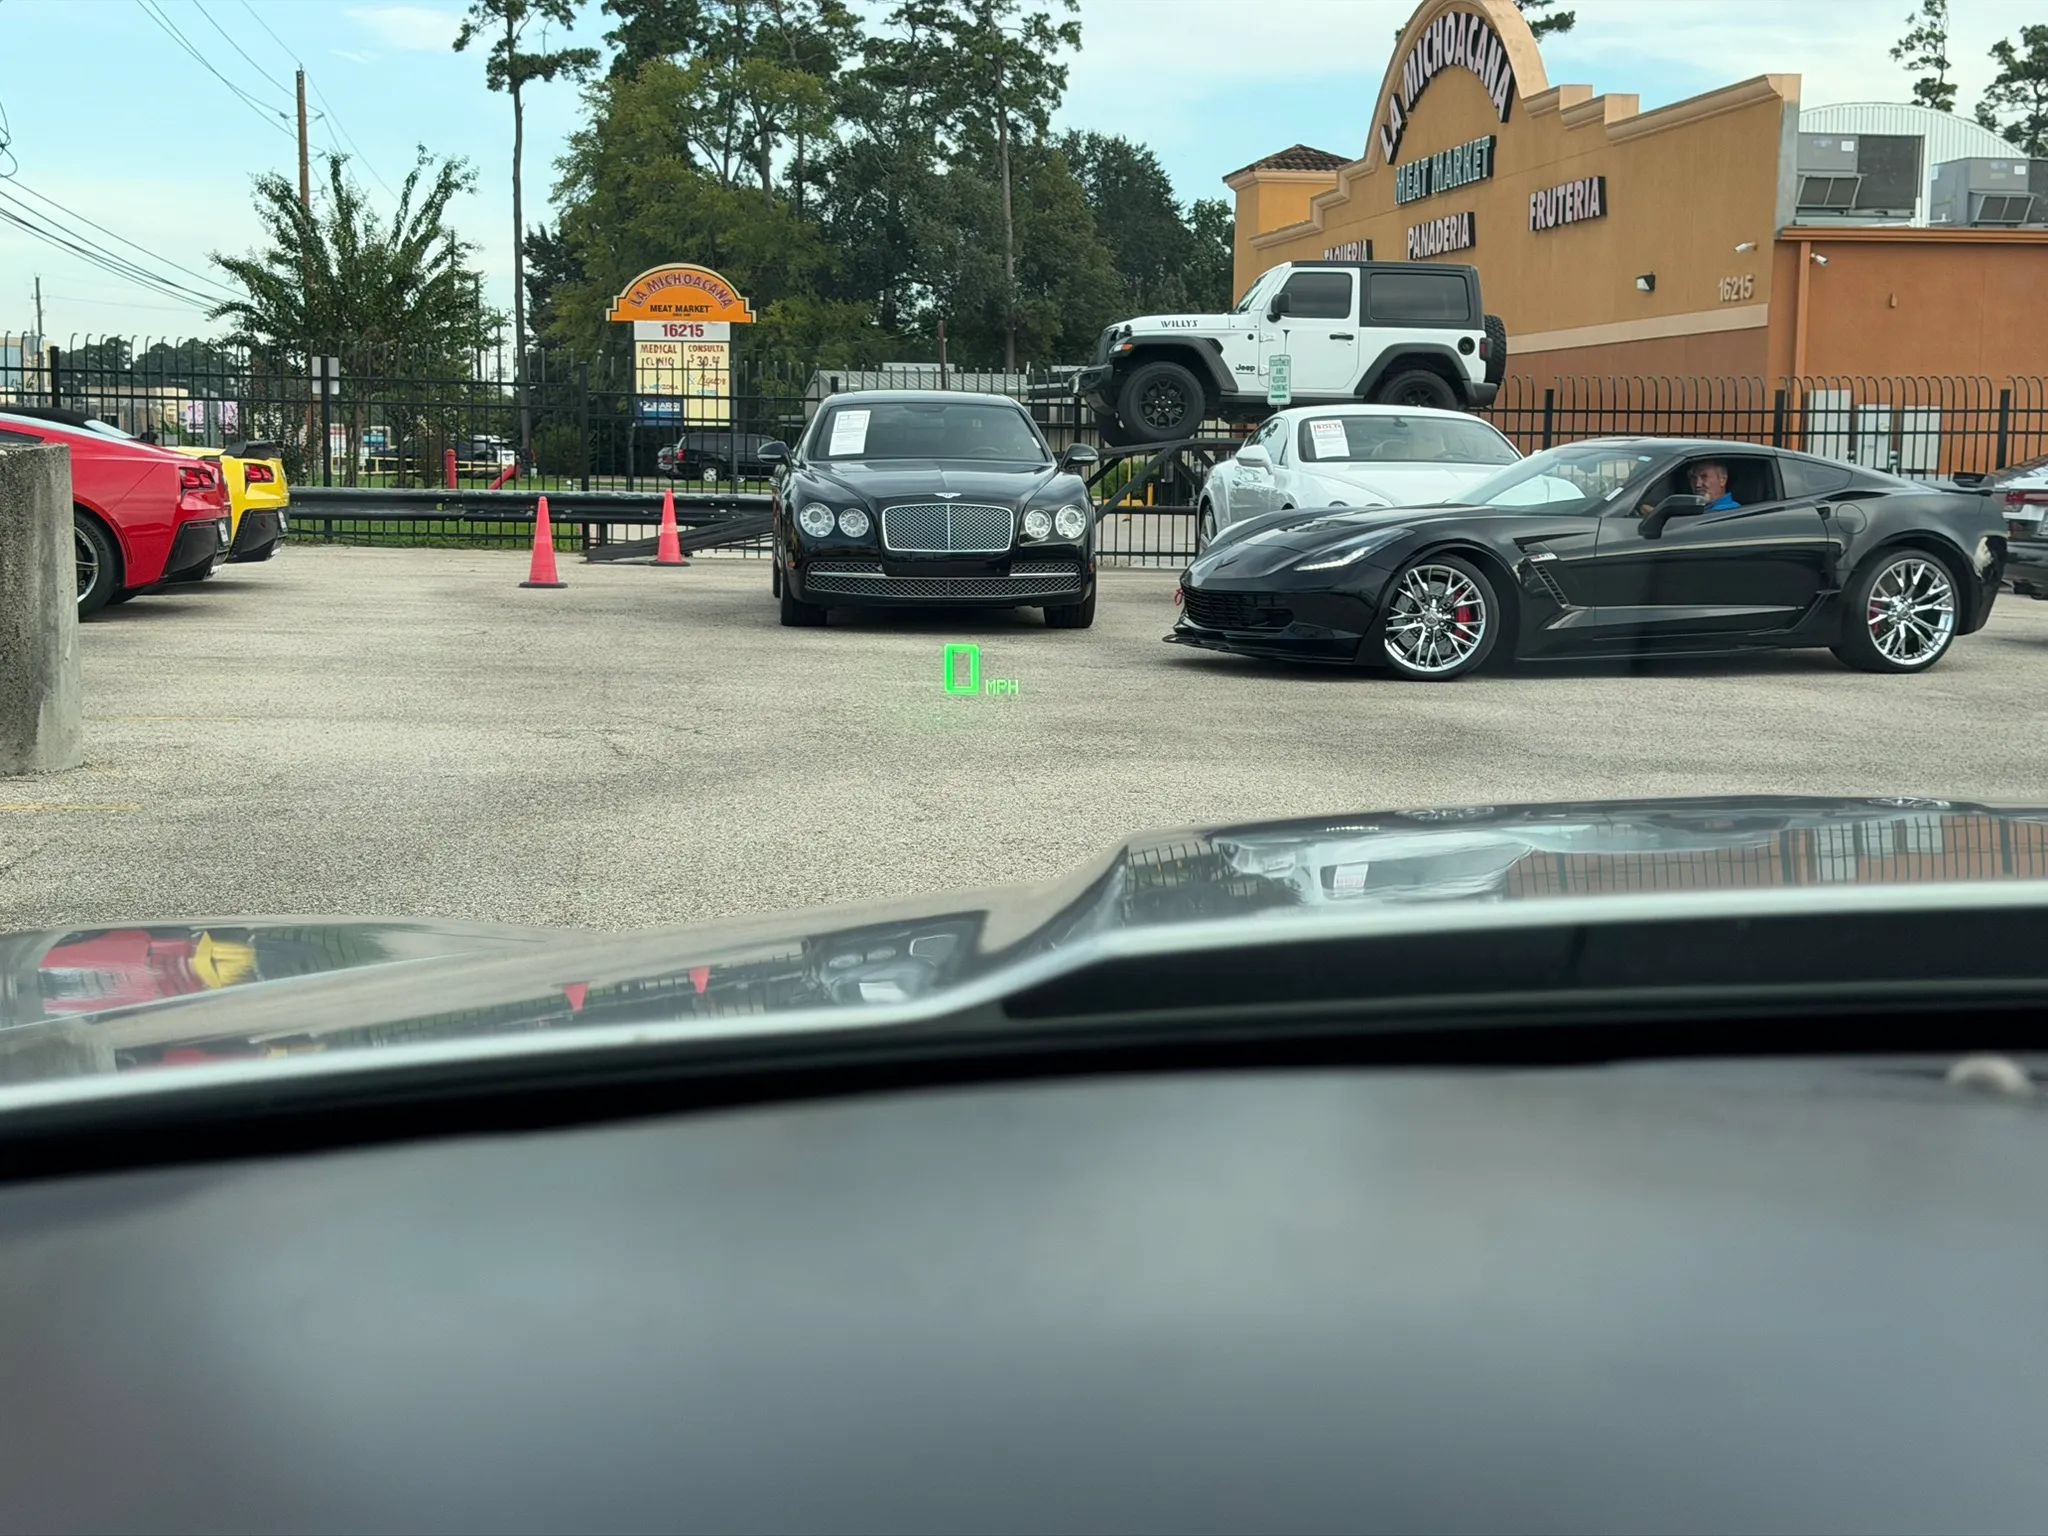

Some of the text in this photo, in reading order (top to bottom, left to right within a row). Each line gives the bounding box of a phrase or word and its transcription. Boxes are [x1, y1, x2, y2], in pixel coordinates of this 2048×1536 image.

[1380, 11, 1516, 165] LA MICHOACANA
[1395, 135, 1496, 205] MEAT MARKET
[1529, 176, 1605, 231] FRUTERIA
[1407, 212, 1474, 260] PANADERIA
[629, 272, 735, 310] LA MICHOACANA
[1719, 274, 1755, 301] 16215
[649, 304, 710, 313] MEAT MARKET
[661, 323, 704, 337] 16215
[1160, 319, 1199, 328] WILLYS
[640, 344, 677, 354] MEDICAL
[687, 344, 725, 353] CONSULTA
[1235, 363, 1256, 372] Jeep
[943, 643, 1019, 696] 0 MPH
